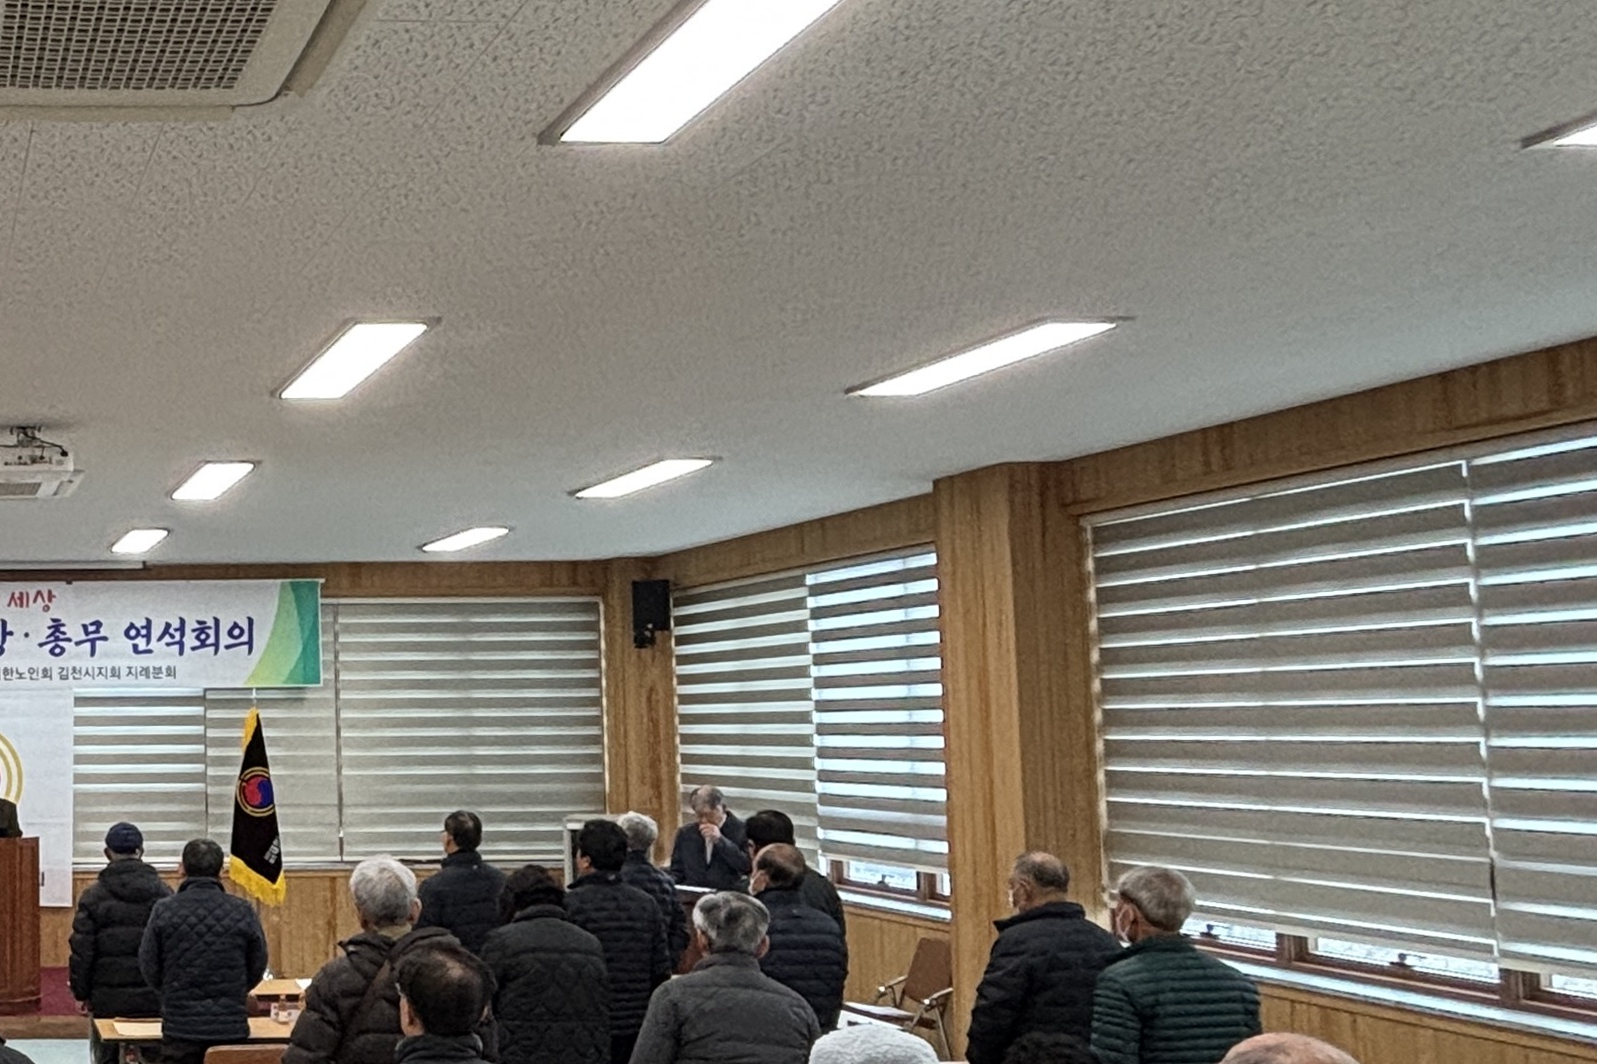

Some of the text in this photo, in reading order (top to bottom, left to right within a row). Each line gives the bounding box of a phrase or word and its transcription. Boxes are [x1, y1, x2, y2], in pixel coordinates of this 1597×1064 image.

[6, 588, 57, 613] 세상
[123, 615, 255, 657] 연석회의
[57, 665, 122, 682] 김천시지회
[125, 664, 178, 682] 지례분회
